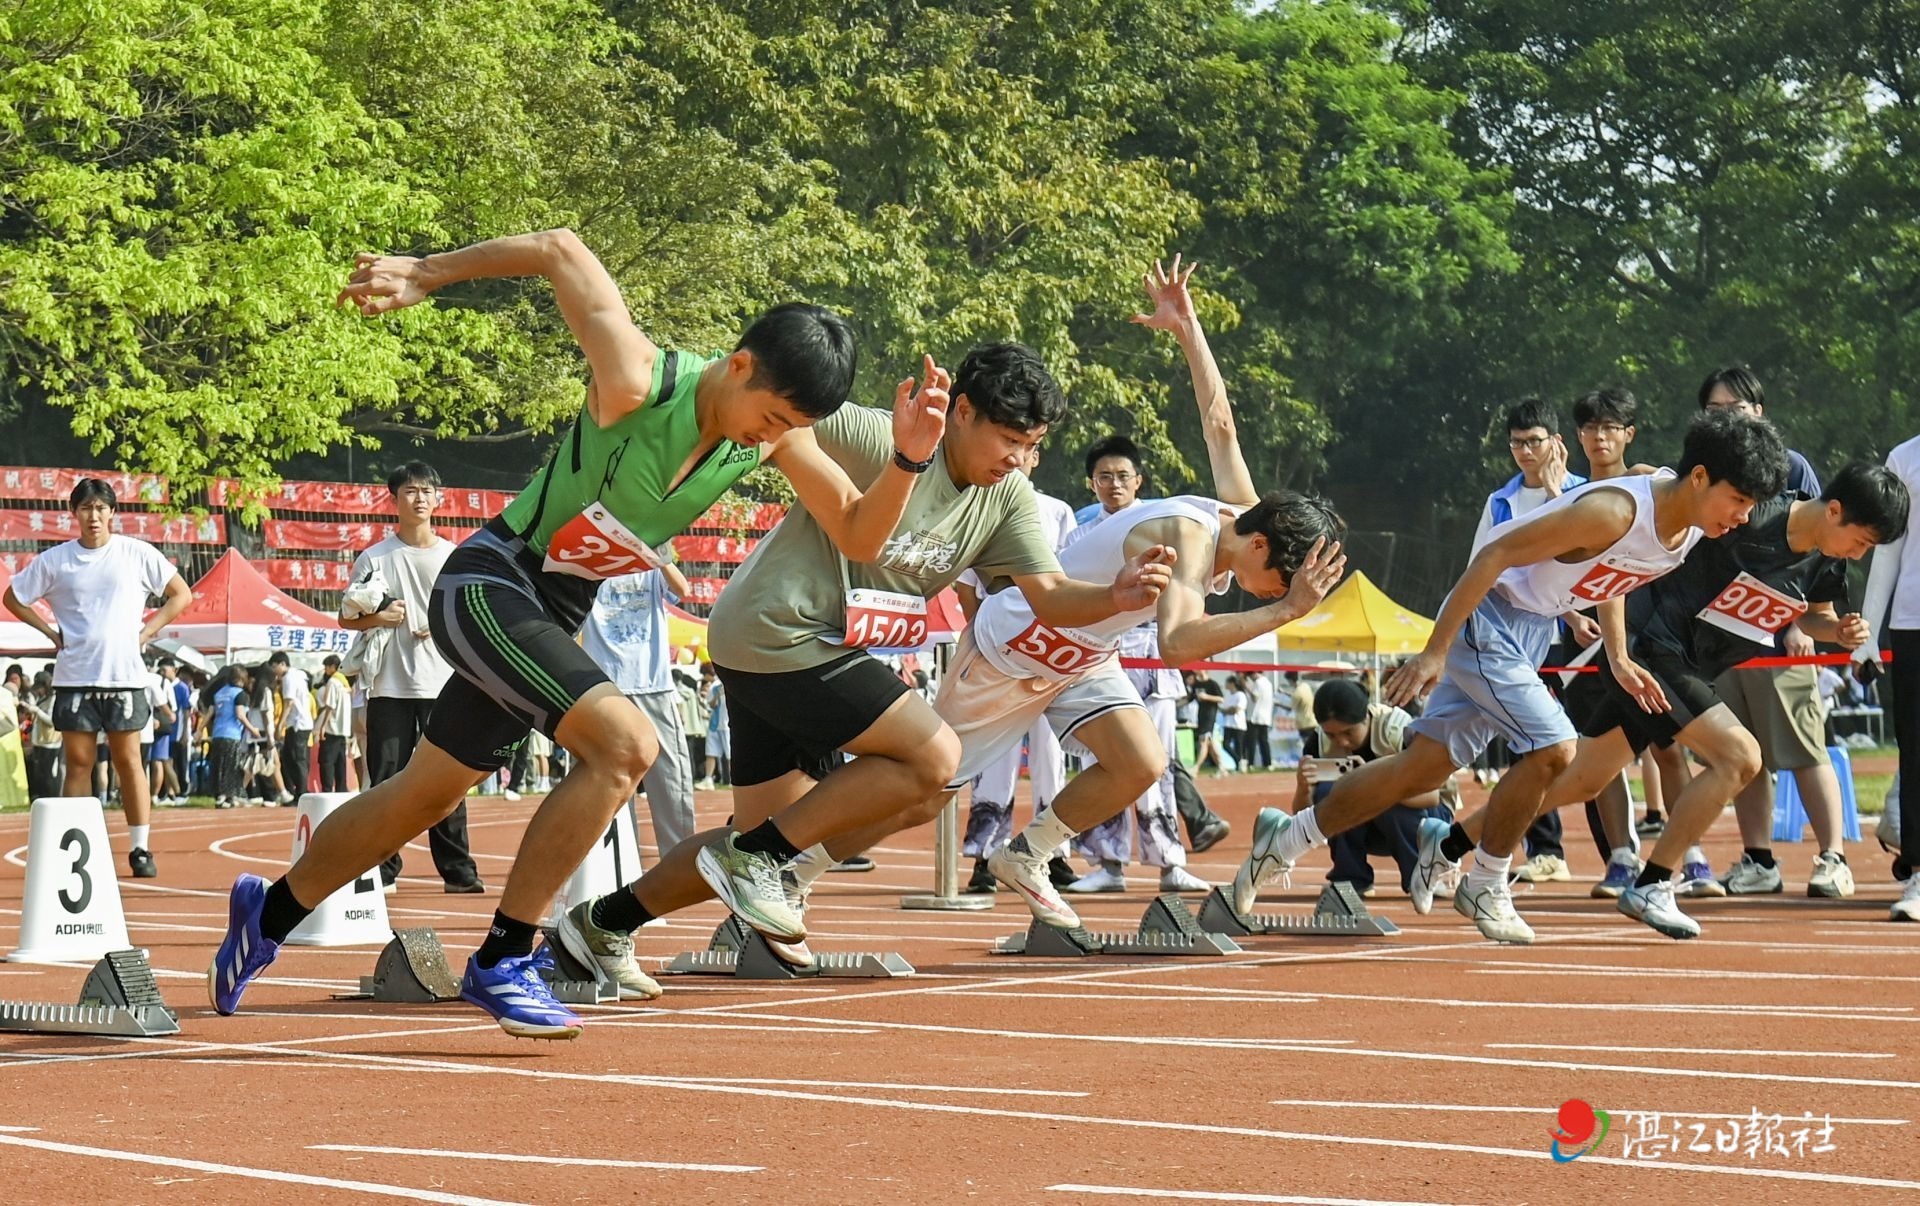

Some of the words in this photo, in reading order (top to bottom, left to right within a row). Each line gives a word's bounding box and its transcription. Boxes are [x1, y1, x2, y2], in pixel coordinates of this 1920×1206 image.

[558, 535, 645, 573] 31
[1715, 586, 1793, 628] 903
[267, 625, 350, 652] 管理学院
[850, 613, 925, 647] 1503
[1018, 624, 1109, 673] 502
[58, 827, 92, 915] 3
